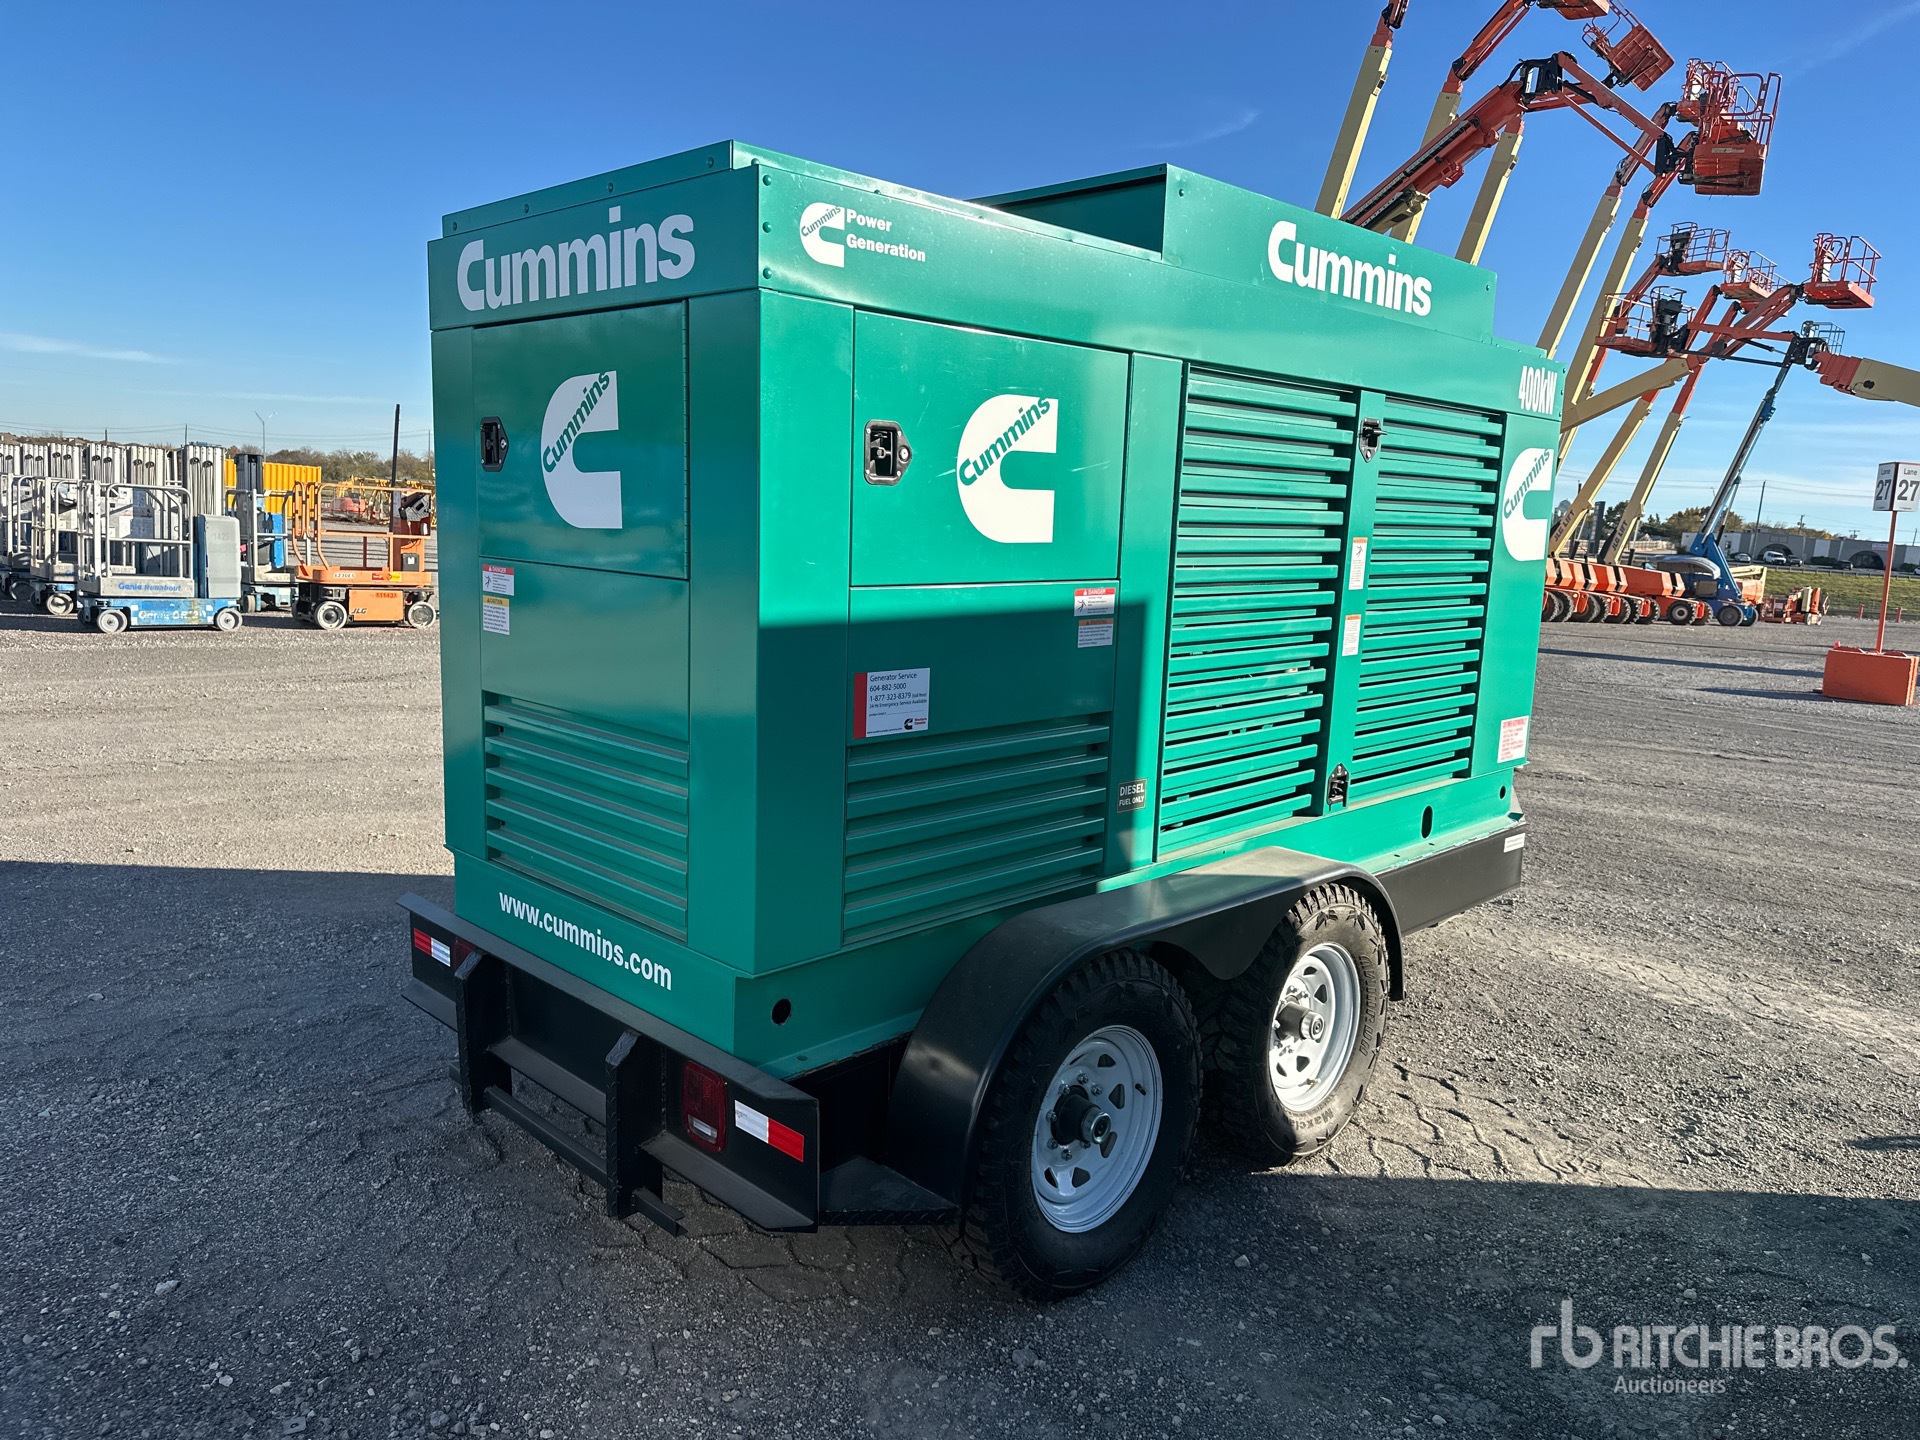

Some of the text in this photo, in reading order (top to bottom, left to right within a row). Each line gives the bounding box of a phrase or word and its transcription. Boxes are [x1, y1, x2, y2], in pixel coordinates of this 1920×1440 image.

[800, 206, 842, 237] Cummins
[846, 208, 892, 232] Power
[456, 205, 696, 312] Cummins
[846, 233, 926, 262] Generation
[1267, 220, 1432, 317] Cummins
[1518, 365, 1558, 415] 400kW
[542, 372, 610, 473] Cummins
[959, 396, 1051, 486] Cummins
[1503, 448, 1550, 520] Cummins
[1903, 468, 1918, 476] Lane
[1875, 479, 1892, 501] 27
[1897, 479, 1920, 501] 27
[1554, 509, 1575, 541] JLG LIFT
[1611, 520, 1628, 551] JLG LIFT
[118, 582, 142, 591] Genie
[869, 672, 917, 682] Generator Service
[869, 682, 907, 692] 604-882-5000
[1120, 783, 1145, 797] DIESEL
[1132, 795, 1145, 804] ONLY
[498, 891, 672, 991] www.cummins.com
